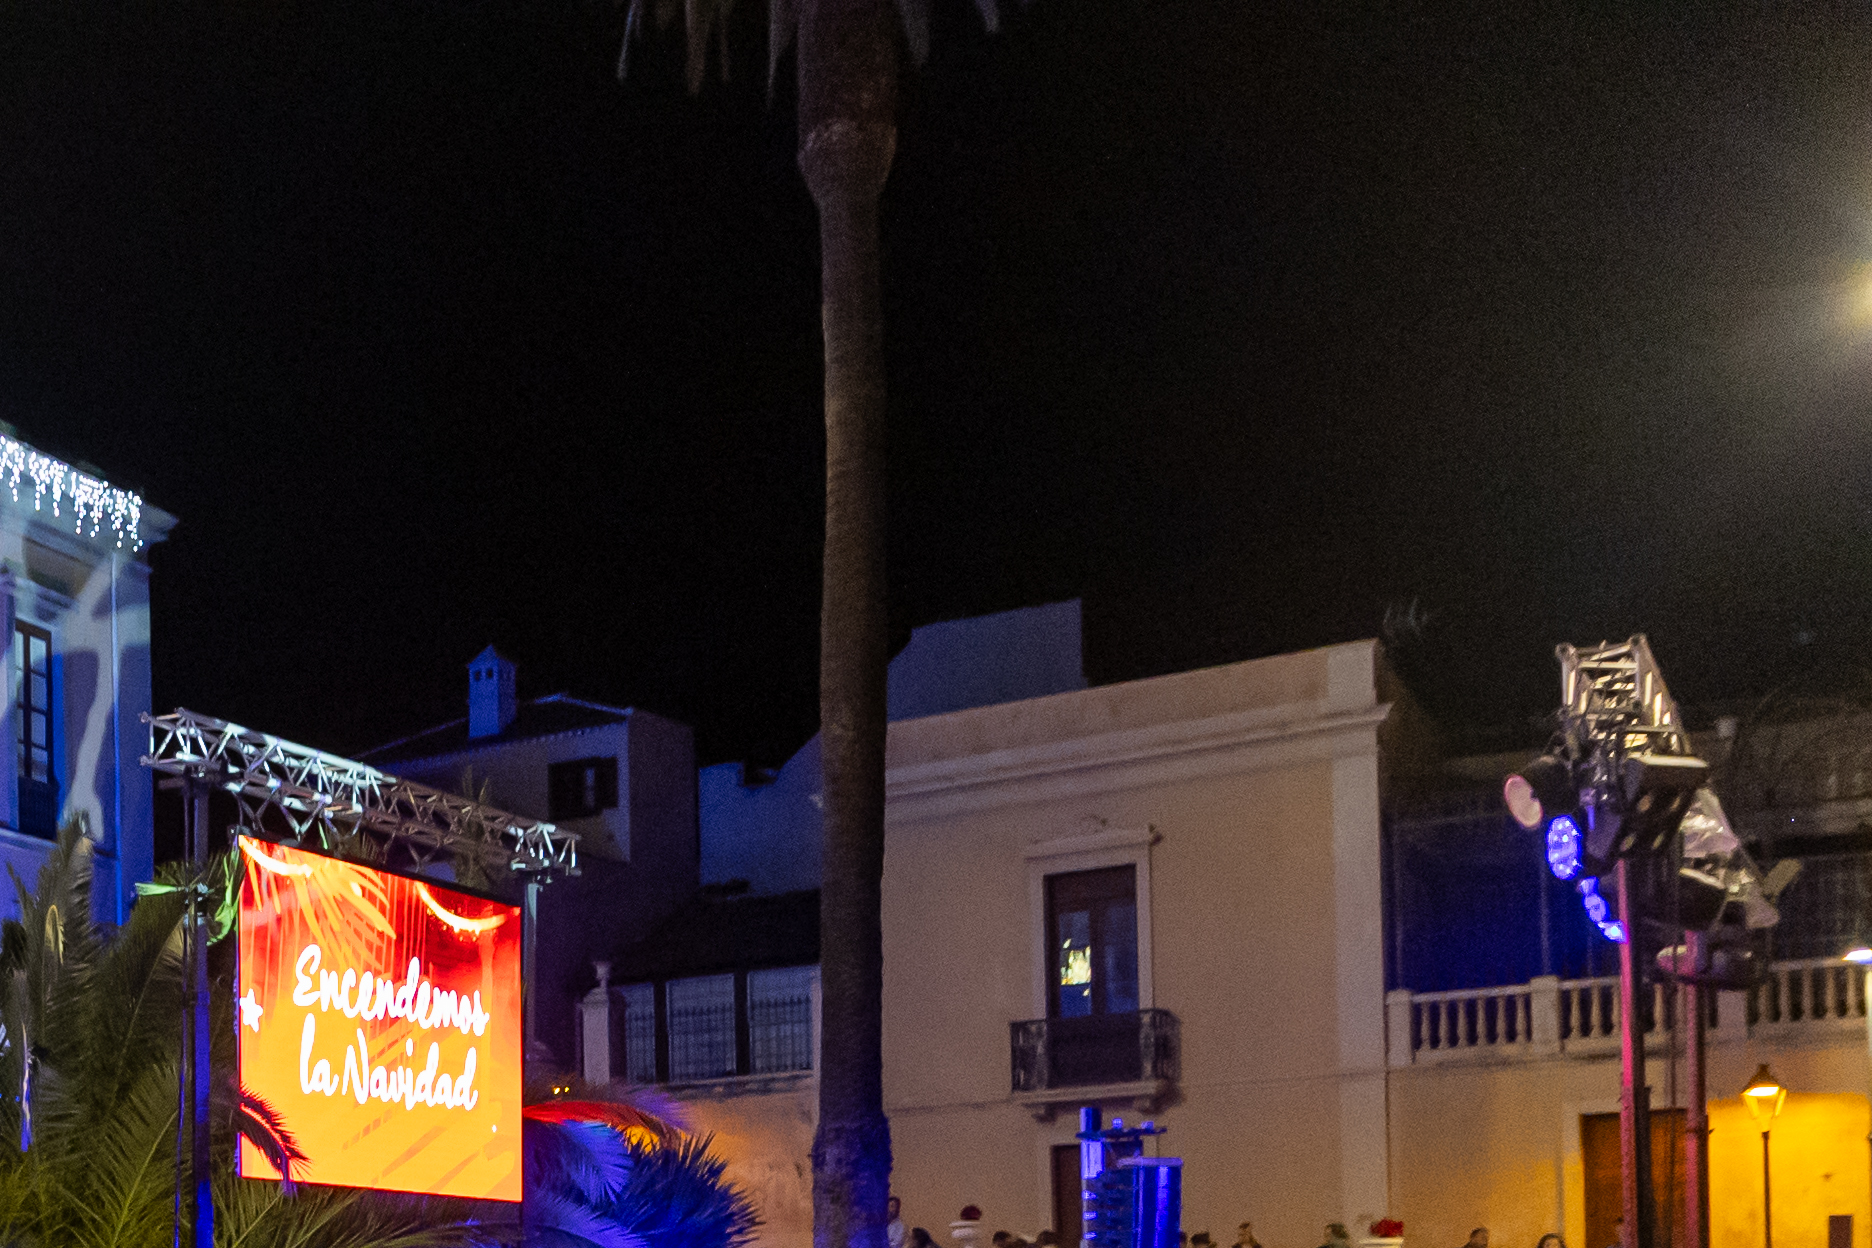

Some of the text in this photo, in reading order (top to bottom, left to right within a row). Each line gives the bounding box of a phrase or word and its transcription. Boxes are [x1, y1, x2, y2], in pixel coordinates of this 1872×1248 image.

[292, 943, 491, 1037] Encendemos
[299, 1012, 479, 1112] la Navidad
